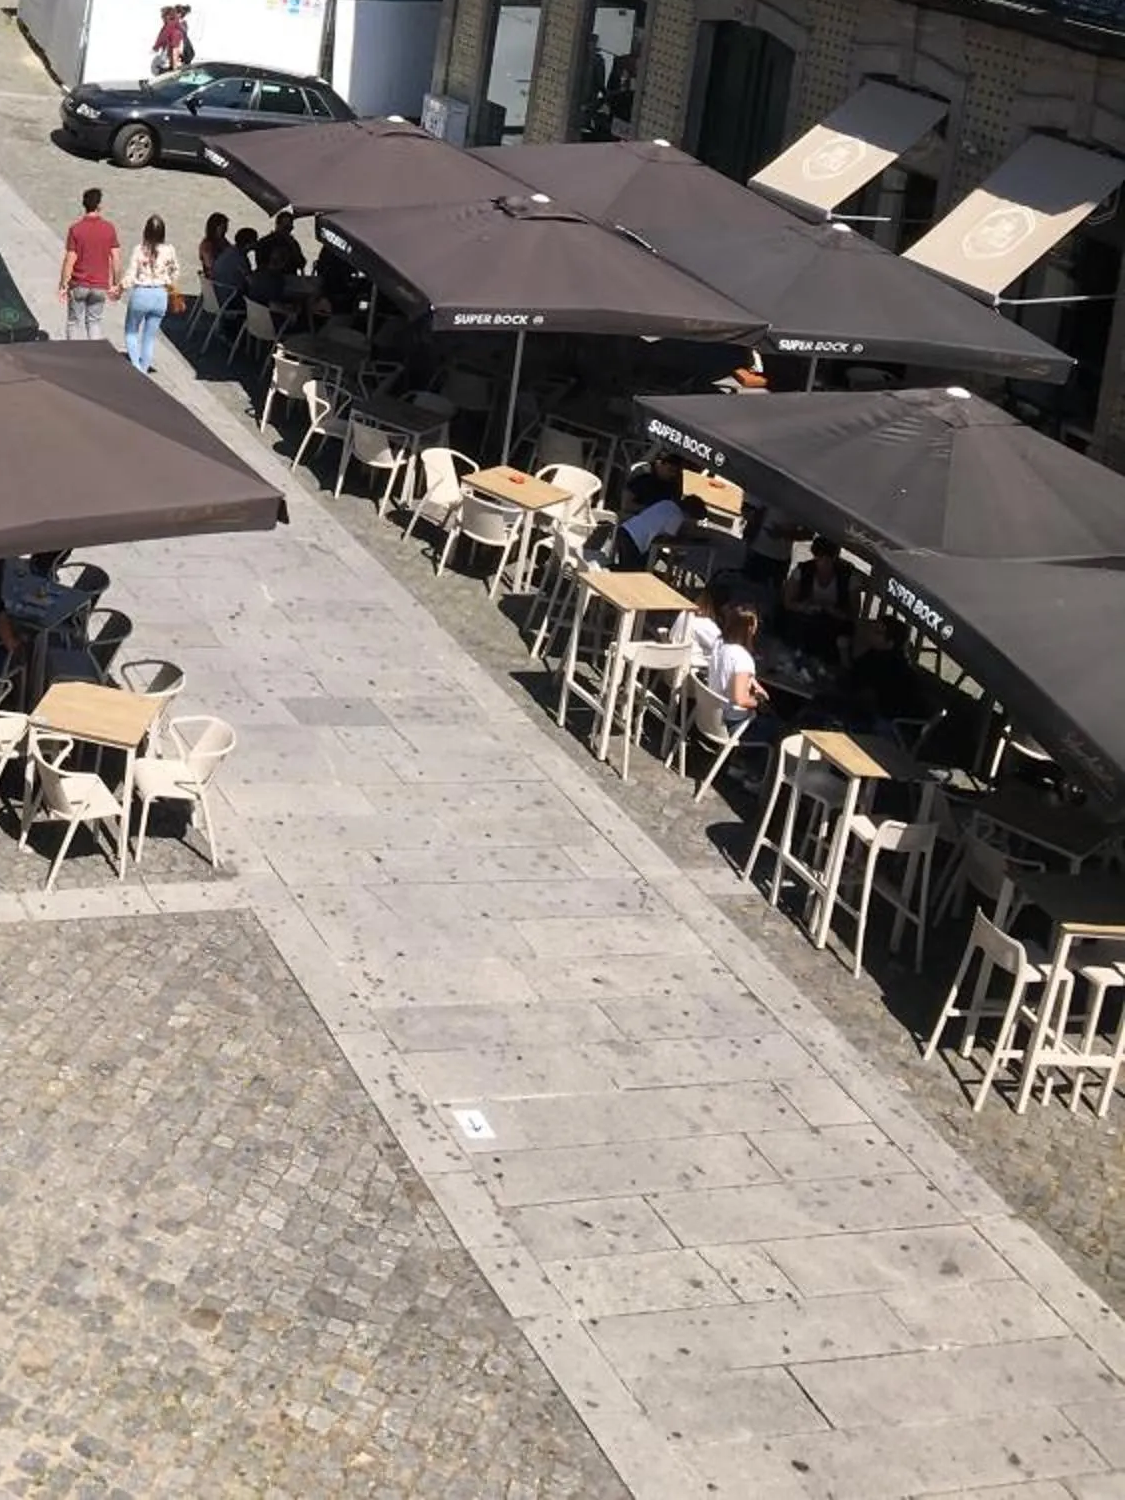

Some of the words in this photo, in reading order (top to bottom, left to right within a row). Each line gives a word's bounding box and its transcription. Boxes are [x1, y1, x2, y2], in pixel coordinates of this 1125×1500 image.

[453, 313, 492, 325] SUPER
[493, 313, 529, 325] BOCK
[648, 419, 683, 446] SUPER
[682, 435, 713, 461] BOCK
[887, 577, 916, 611] SUPER
[912, 599, 944, 632] BOCK
